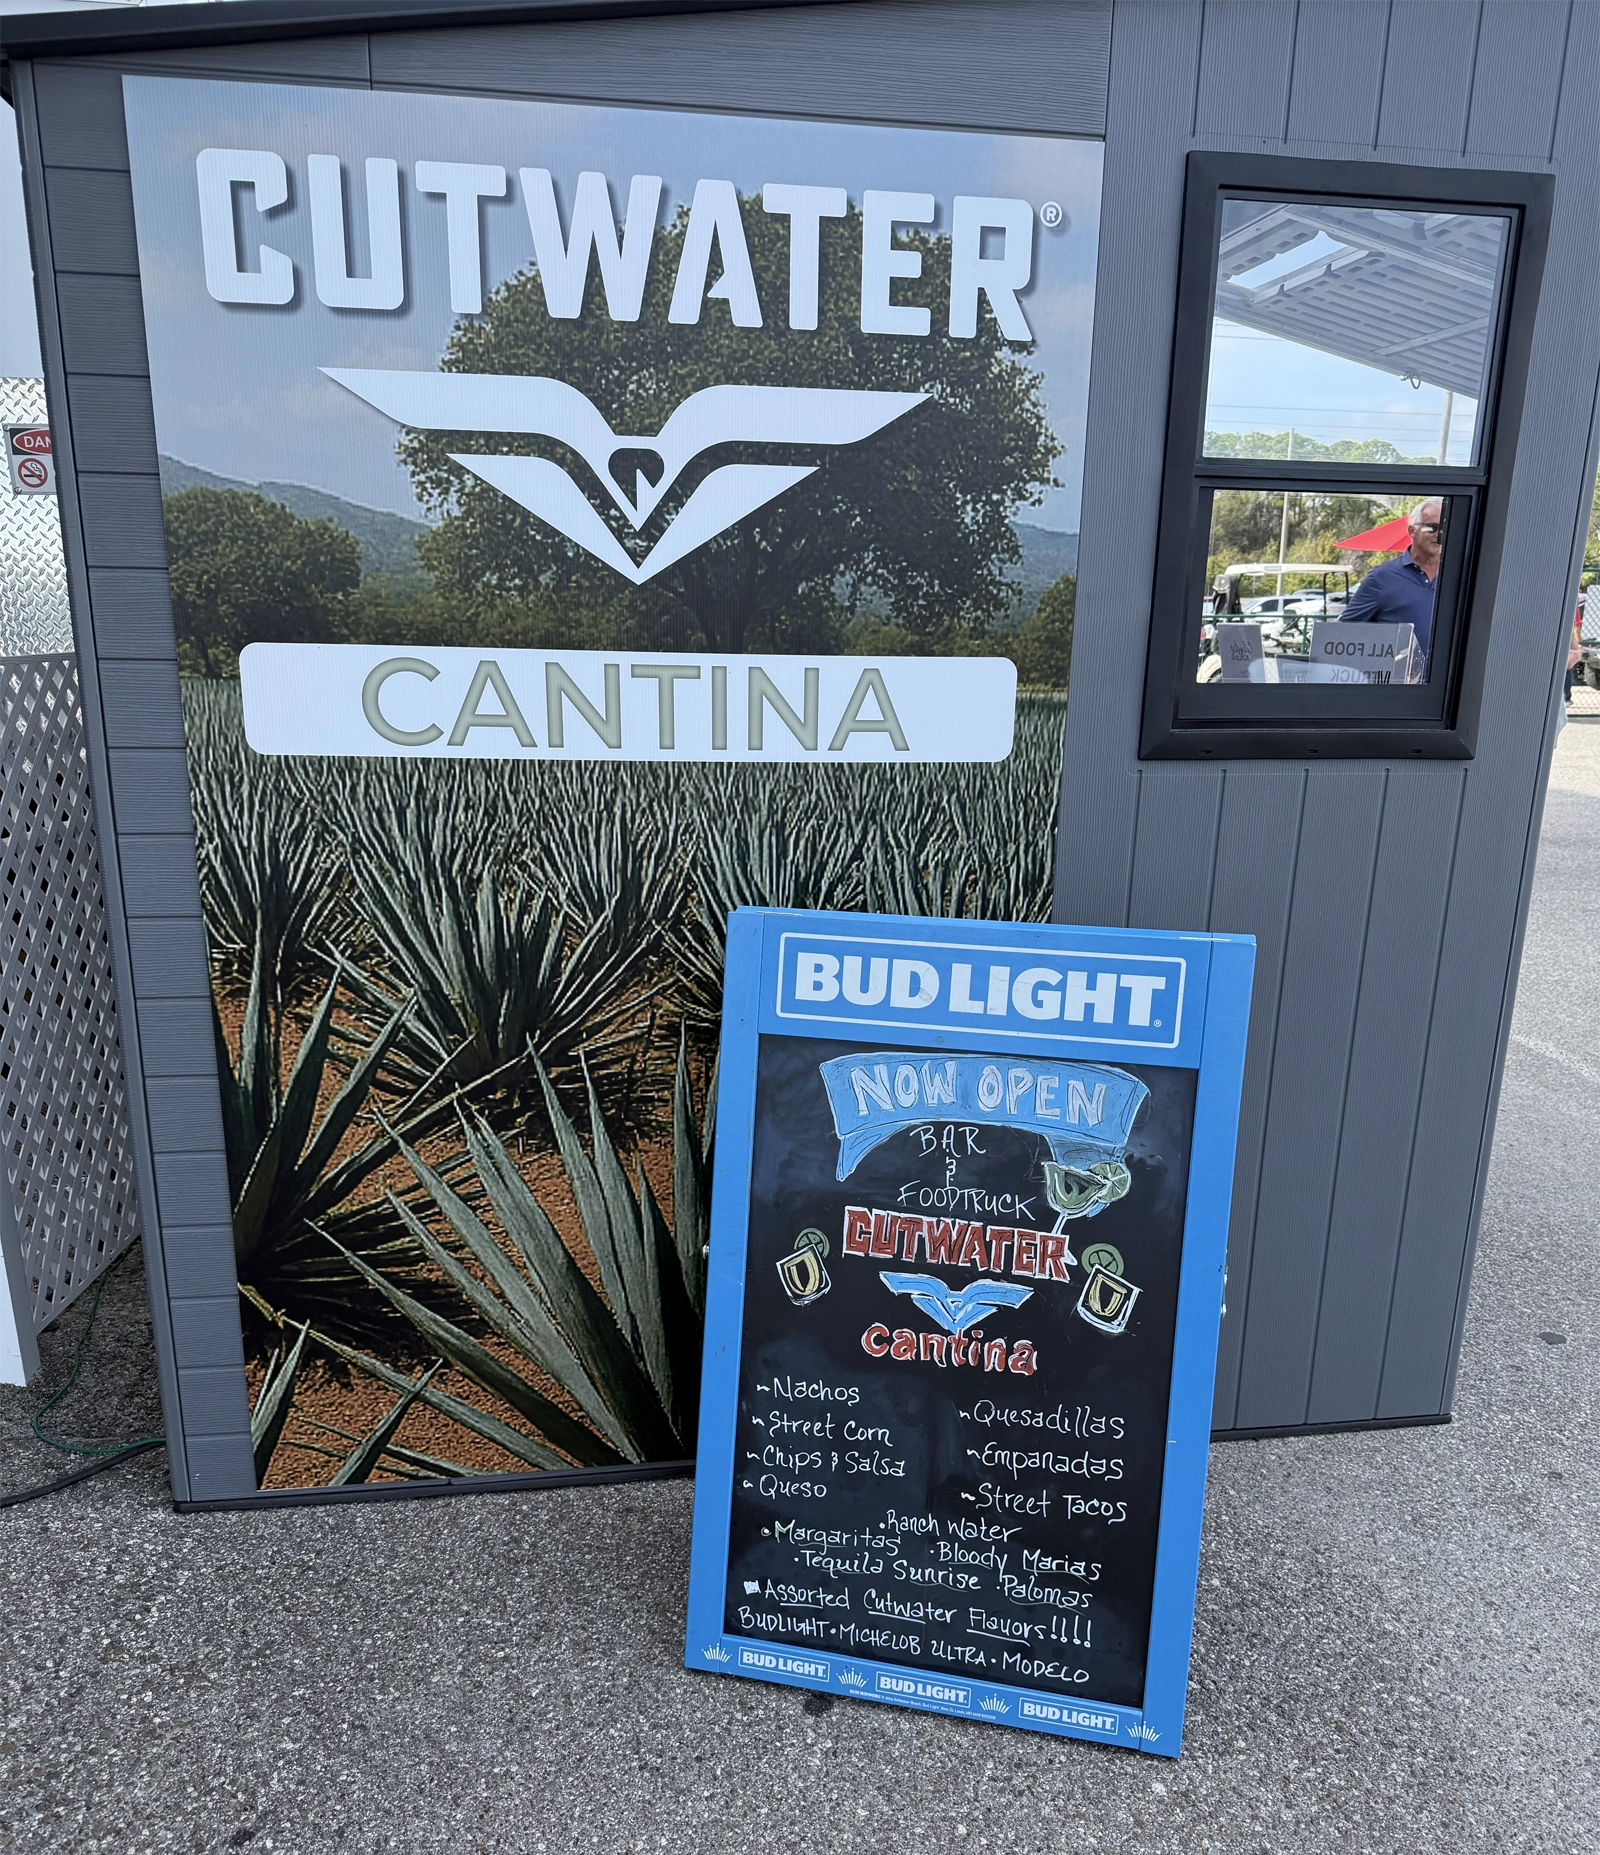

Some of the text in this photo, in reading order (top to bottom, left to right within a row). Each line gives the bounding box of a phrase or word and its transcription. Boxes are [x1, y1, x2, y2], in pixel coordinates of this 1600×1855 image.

[24, 436, 52, 448] DAN
[361, 656, 910, 752] CANTINA
[794, 951, 940, 1010] BUD
[850, 1060, 1106, 1127] NOW OPEN
[909, 1124, 986, 1158] BAR
[896, 1180, 1037, 1221] FOODTRUCK
[842, 1205, 1072, 1283] CUTWATER
[861, 1321, 1039, 1376] cantina
[773, 1375, 860, 1406] Nachos
[769, 1410, 893, 1447] Street Corn
[973, 1399, 1125, 1440] Quesadillas
[763, 1445, 822, 1475] Chips
[845, 1450, 906, 1477] Salsa
[981, 1441, 1124, 1482] Empanadas
[759, 1473, 828, 1500] Queso
[976, 1482, 1128, 1525] Street Tacos
[886, 1509, 1022, 1543] Ranch Water
[775, 1519, 1102, 1583] Margaritas Bloody Marias
[800, 1550, 1093, 1608] Tequila Sunrise Palomas
[764, 1578, 850, 1610] Assorted
[863, 1588, 957, 1624] Cutwater
[742, 1651, 777, 1668] BUD
[839, 1622, 922, 1655] MICHELOB
[931, 1640, 987, 1667] ULTRA
[1003, 1651, 1090, 1683] MODELO
[879, 1676, 916, 1694] BUD
[1023, 1702, 1060, 1720] BUD
